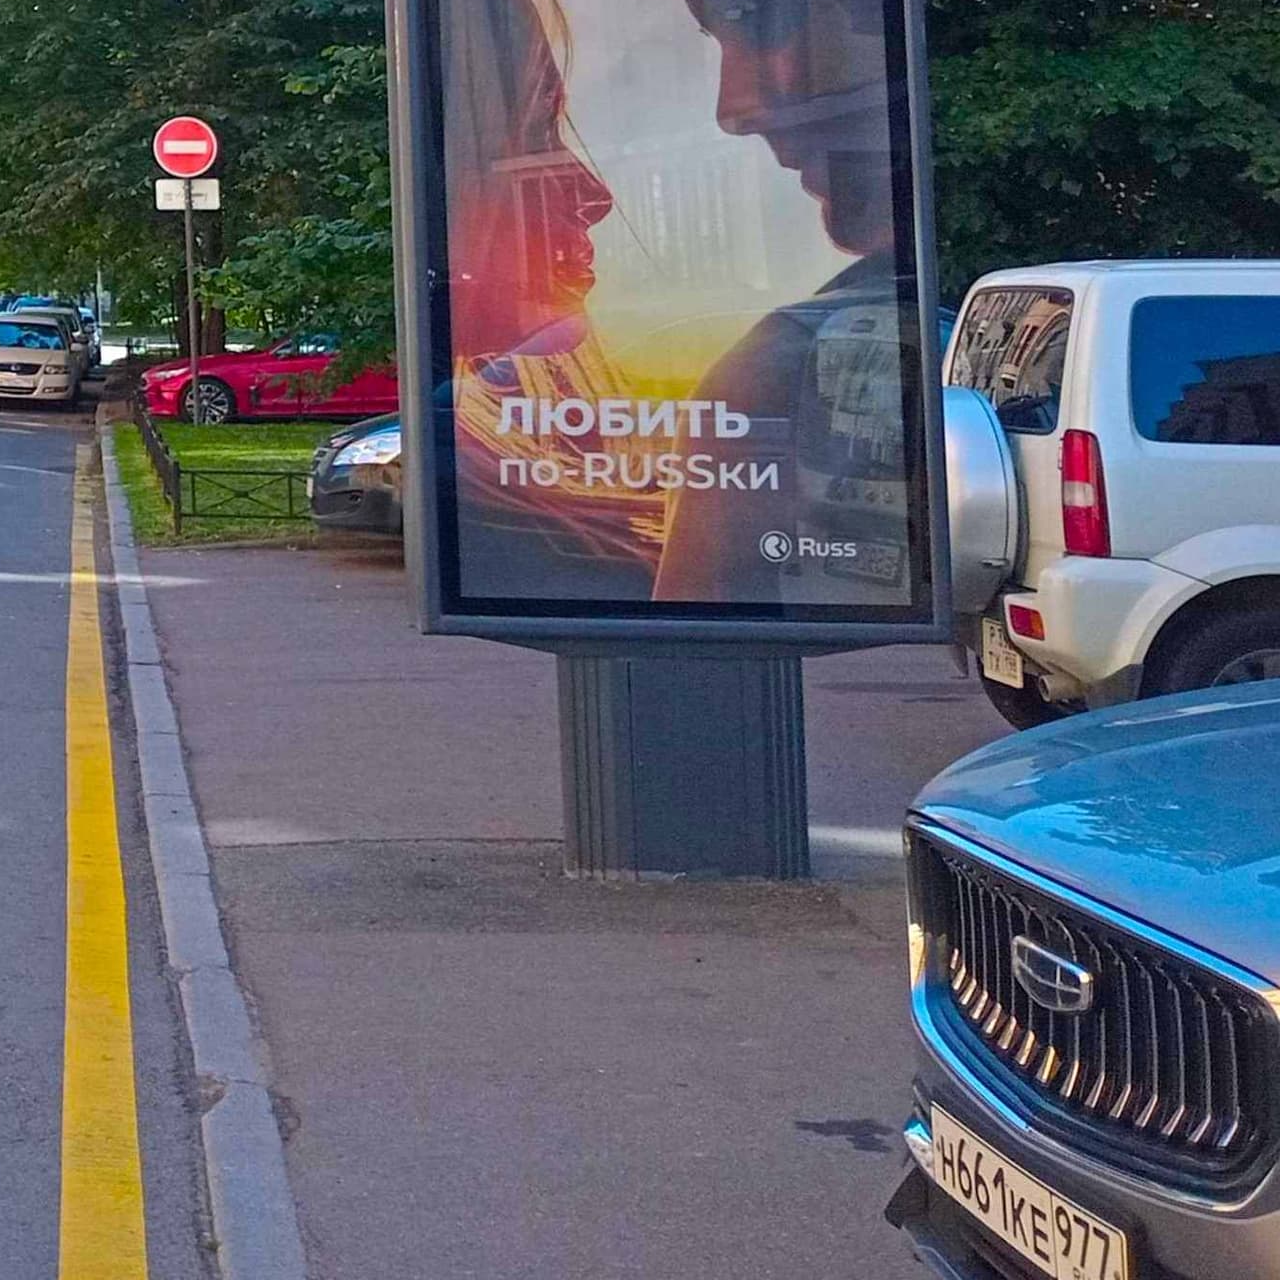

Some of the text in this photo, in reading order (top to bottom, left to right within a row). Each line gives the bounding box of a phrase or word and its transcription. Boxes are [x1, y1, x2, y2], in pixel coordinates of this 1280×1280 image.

[496, 396, 751, 439] ЛЮБИТЬ
[499, 451, 781, 491] по-RUSSки
[797, 537, 857, 558] Russ
[940, 1135, 1111, 1280] Н661КЕ 977
